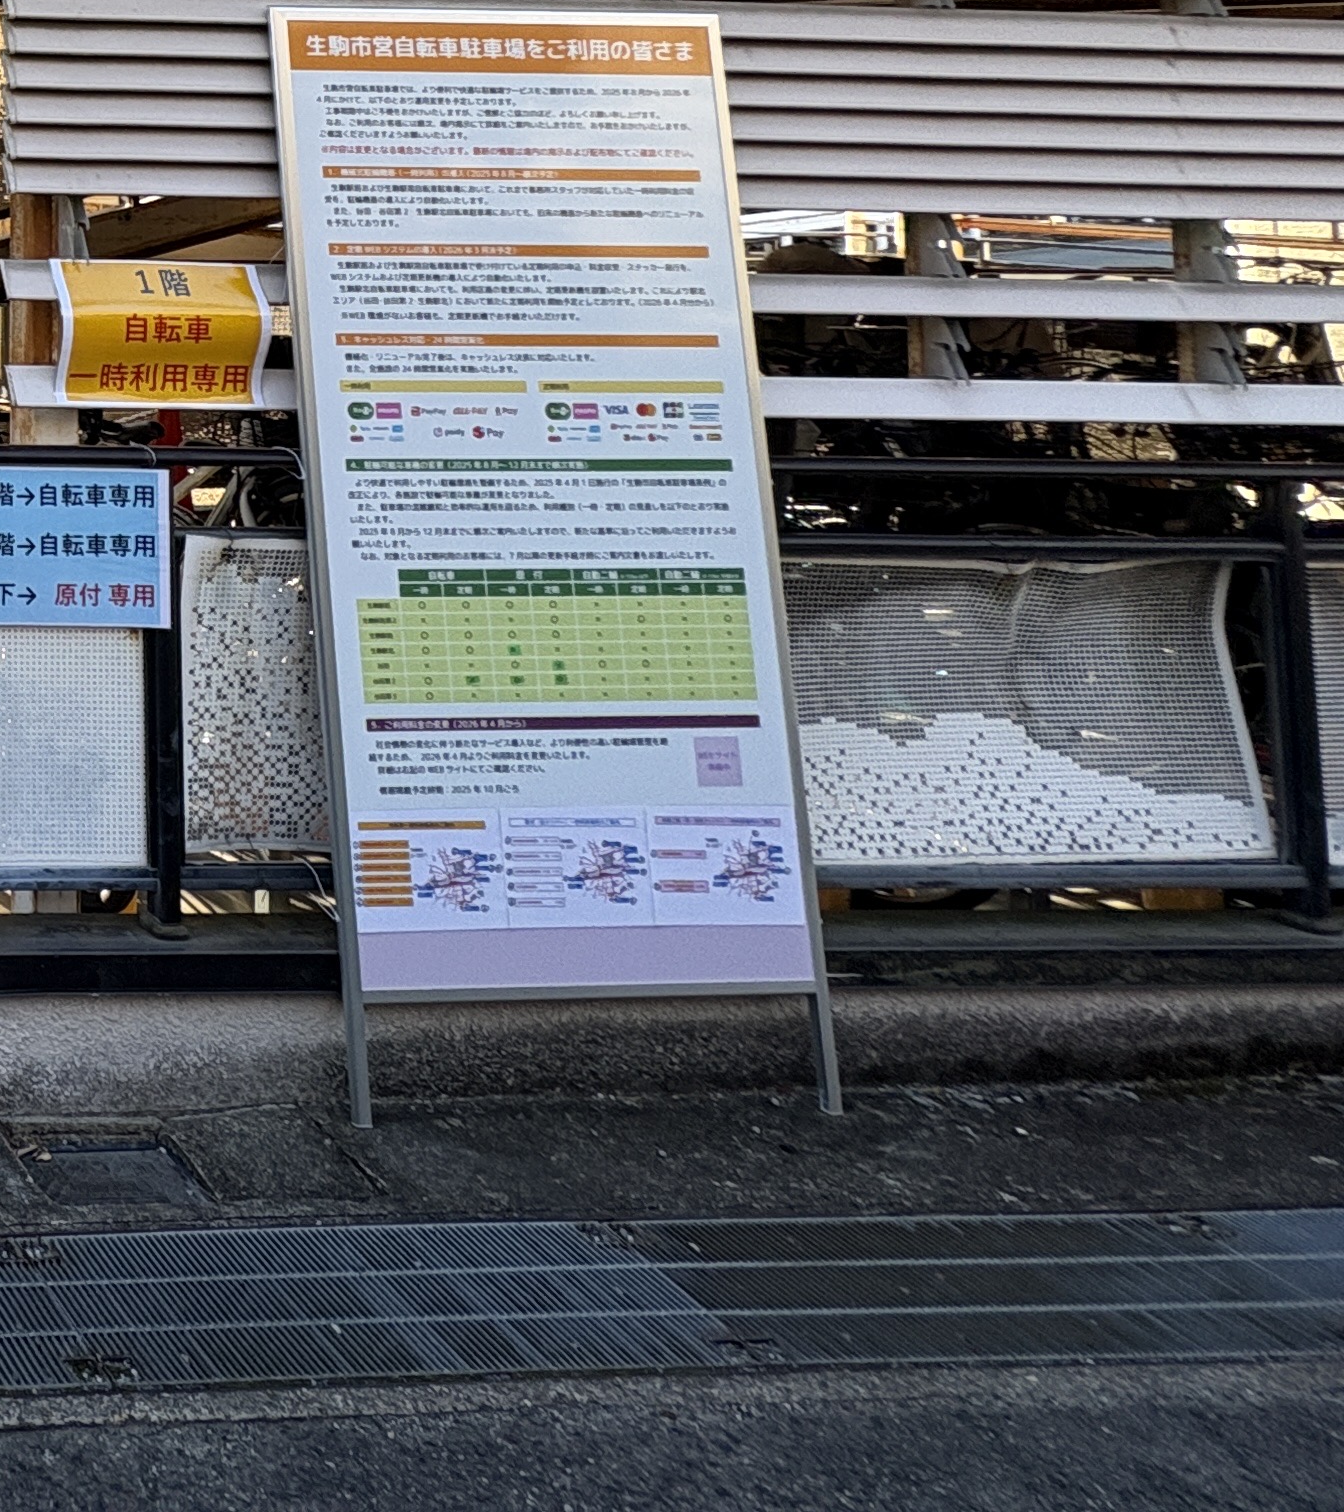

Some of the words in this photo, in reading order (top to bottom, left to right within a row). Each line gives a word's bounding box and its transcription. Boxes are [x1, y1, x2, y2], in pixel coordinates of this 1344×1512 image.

[306, 34, 693, 62] 生駒市営自転車駐車場をご利用の皆さま
[134, 269, 191, 297] 1階
[124, 313, 212, 343] 自転車
[69, 362, 250, 393] 一時利用専用
[604, 405, 629, 415] VISA
